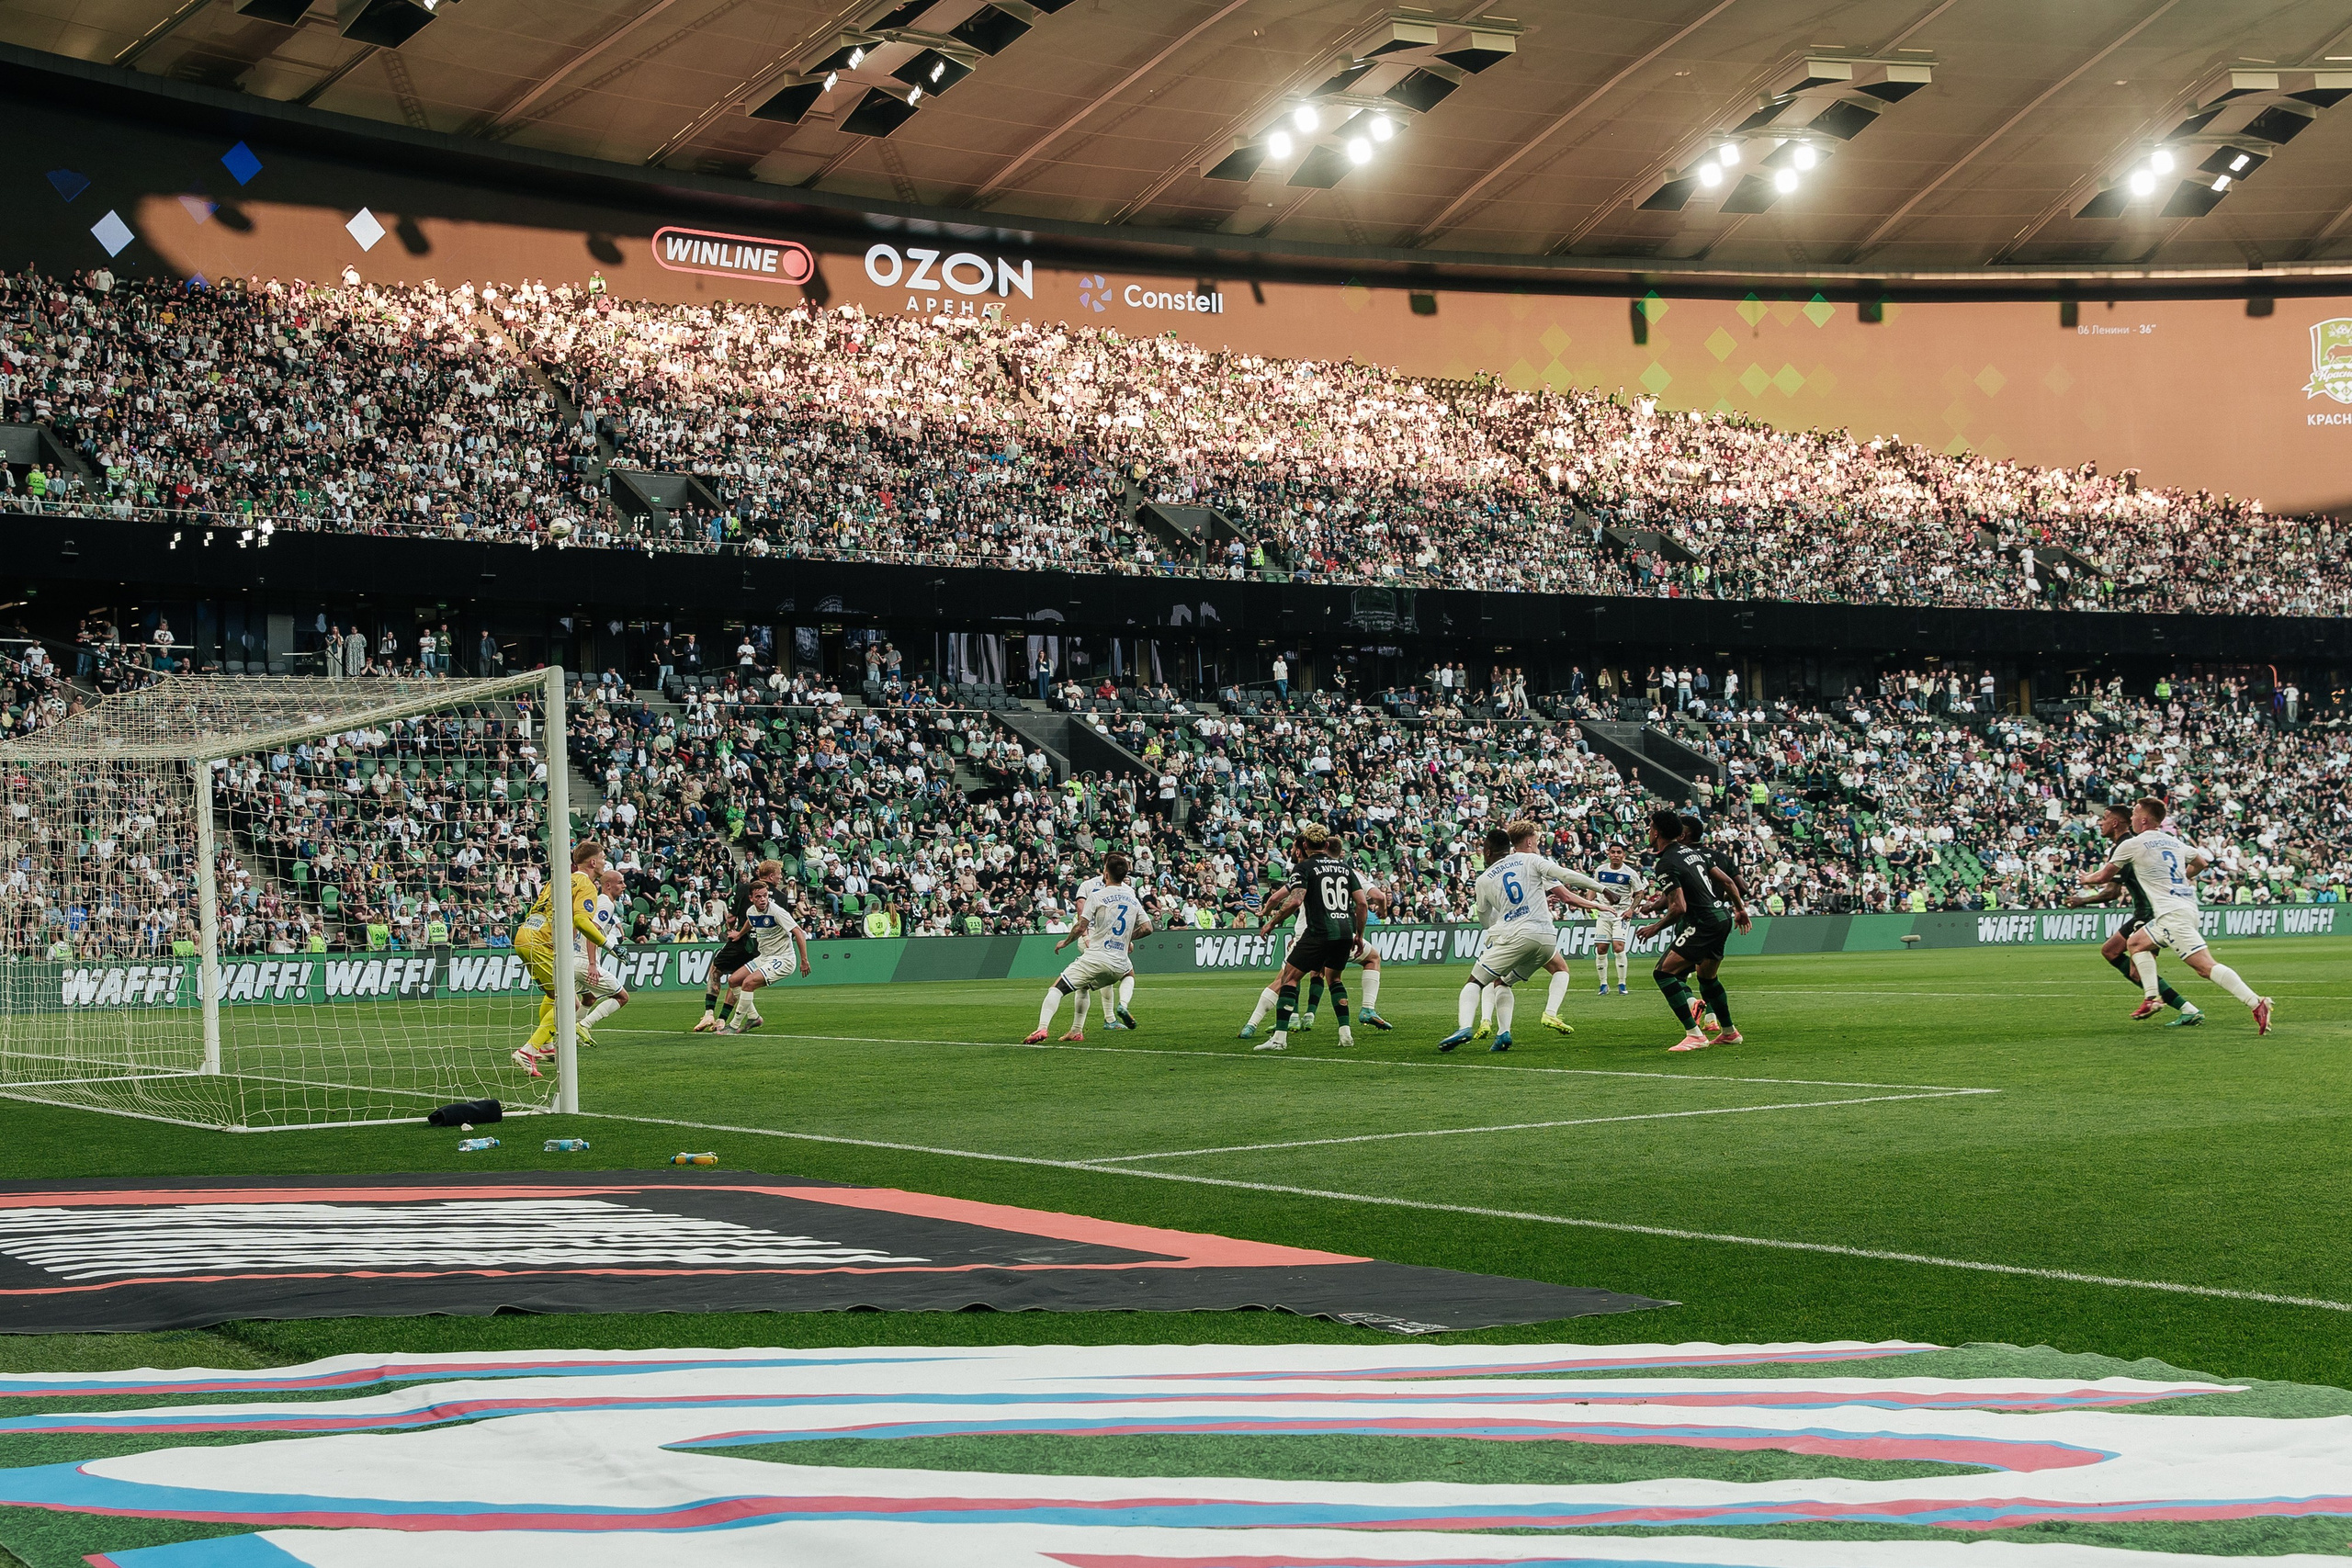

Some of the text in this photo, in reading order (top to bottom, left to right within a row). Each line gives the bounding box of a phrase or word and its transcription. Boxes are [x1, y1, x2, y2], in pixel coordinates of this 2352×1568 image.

[666, 236, 779, 273] WINLINE
[865, 243, 1034, 299] OZON
[1124, 284, 1224, 314] Constell
[2077, 324, 2090, 334] 06
[1487, 860, 1523, 879] ПАЛАСИОС
[2162, 851, 2184, 884] 2
[1320, 875, 1349, 911] 66
[1503, 872, 1524, 905] 6
[1112, 904, 1129, 936] 3
[1978, 915, 2036, 942] WAFF!
[2042, 913, 2099, 941] WAFF!
[2225, 909, 2278, 935] WAFF!
[2283, 908, 2335, 933] WAFF!
[2164, 928, 2175, 943] 2
[1195, 934, 1276, 966] WAFF!
[1371, 930, 1446, 961] WAFF!
[62, 965, 184, 1005] WAFF!
[324, 958, 436, 997] WAFF!
[601, 951, 669, 987] AFF!
